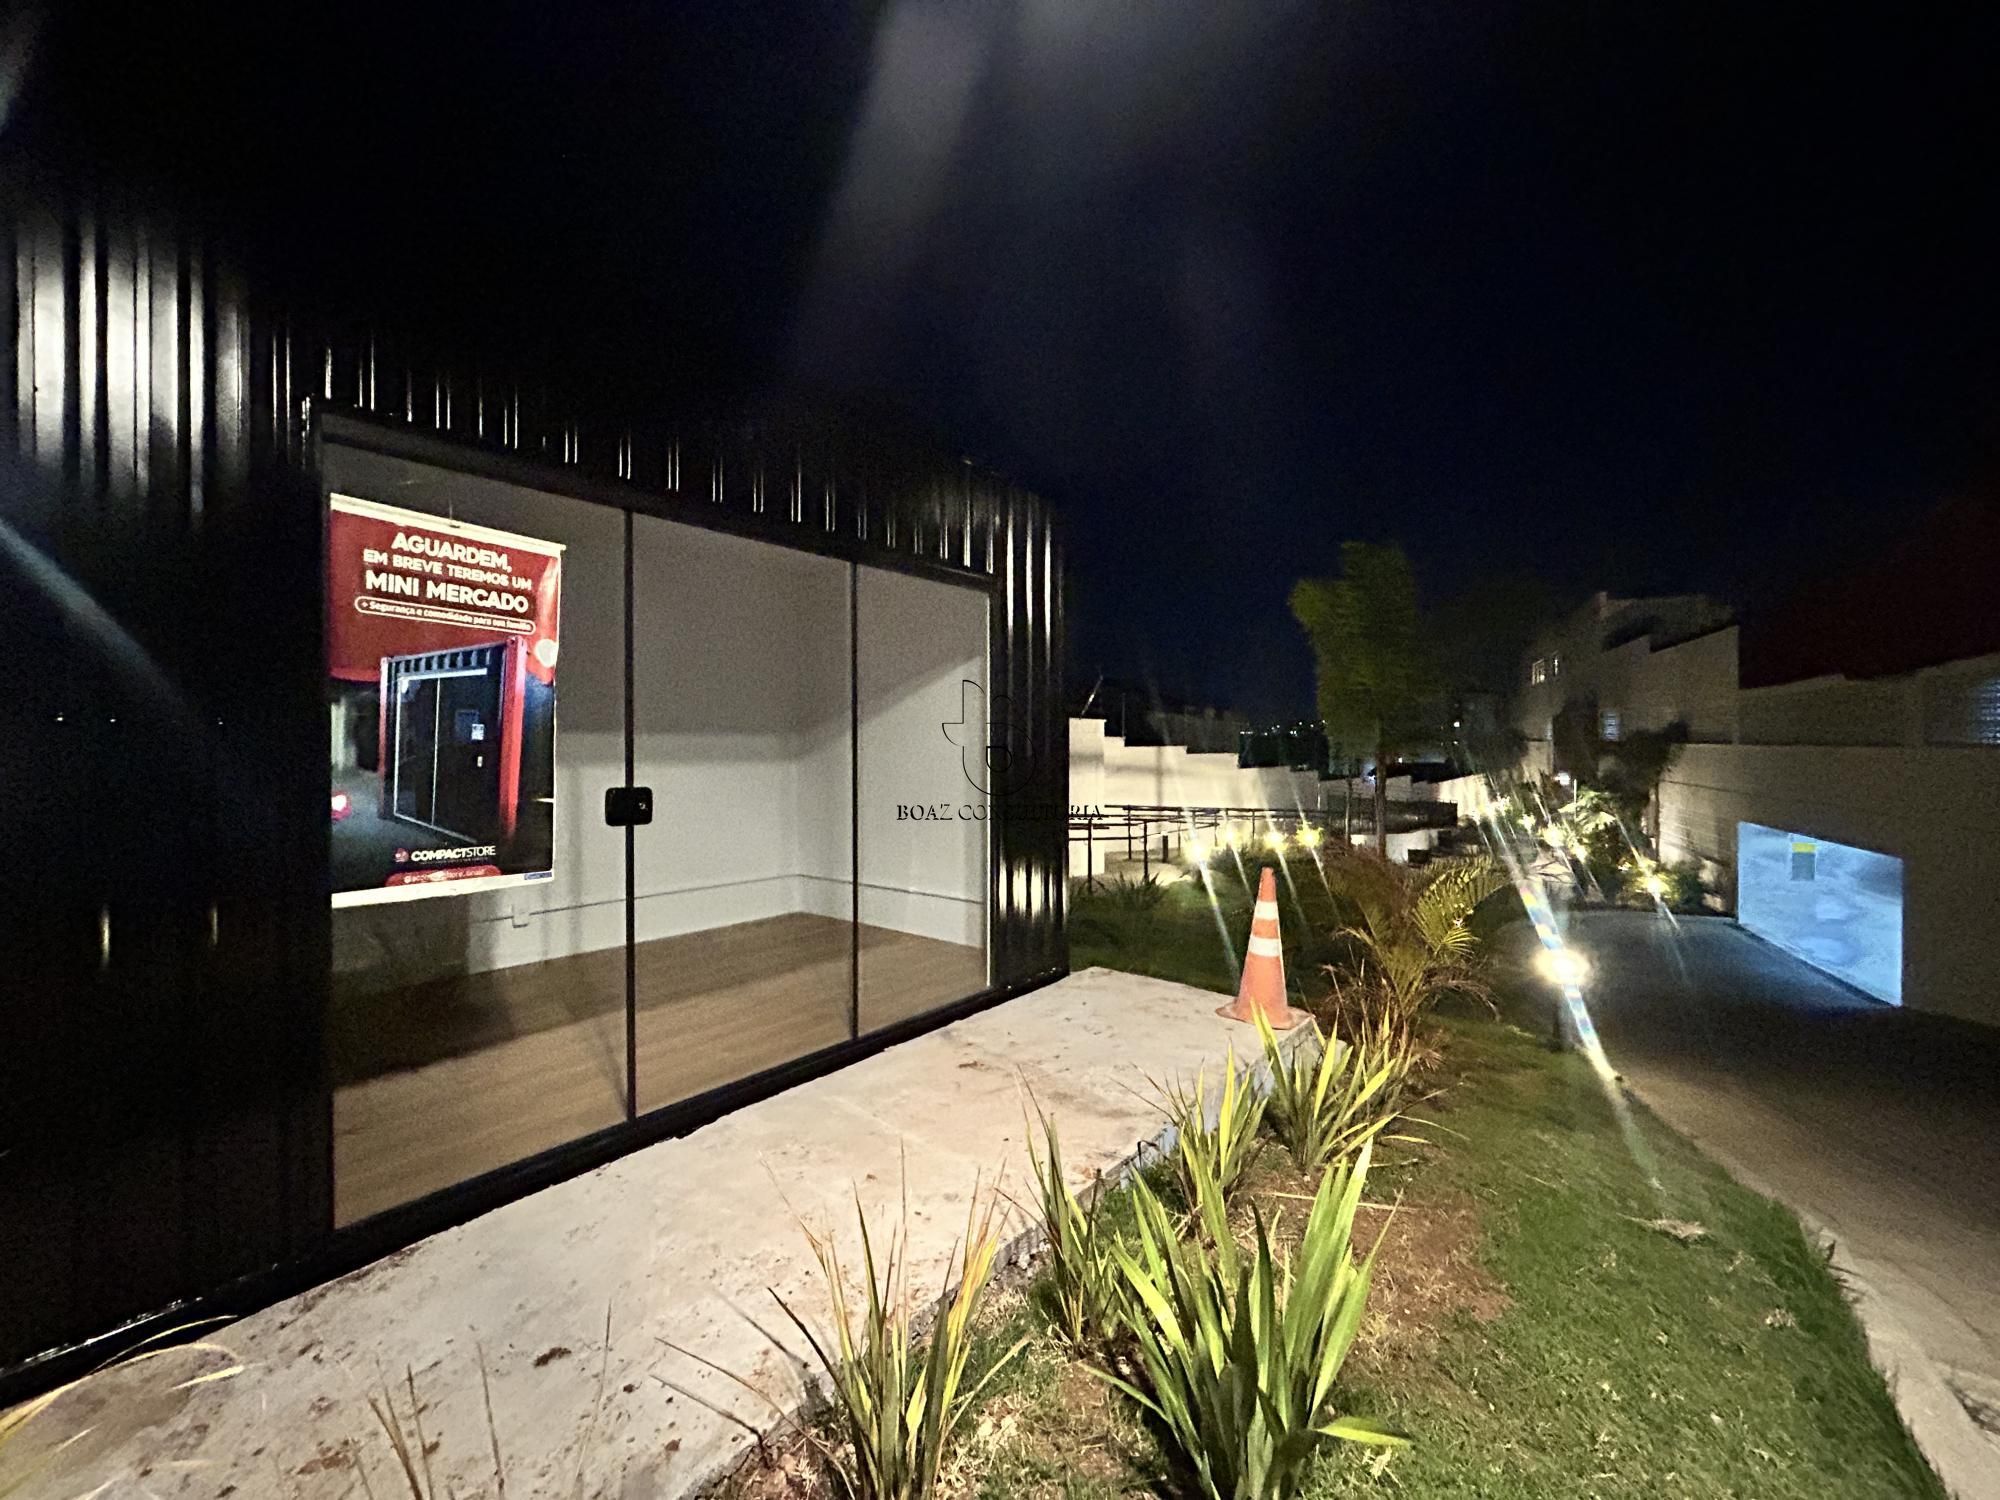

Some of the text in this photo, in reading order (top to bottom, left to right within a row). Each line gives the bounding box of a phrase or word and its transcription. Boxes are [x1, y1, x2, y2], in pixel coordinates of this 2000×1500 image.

[363, 549, 532, 590] EM BREVE TEREMOS UM
[391, 532, 512, 573] AGUARDEM,
[365, 570, 529, 613] MINI MERCADO
